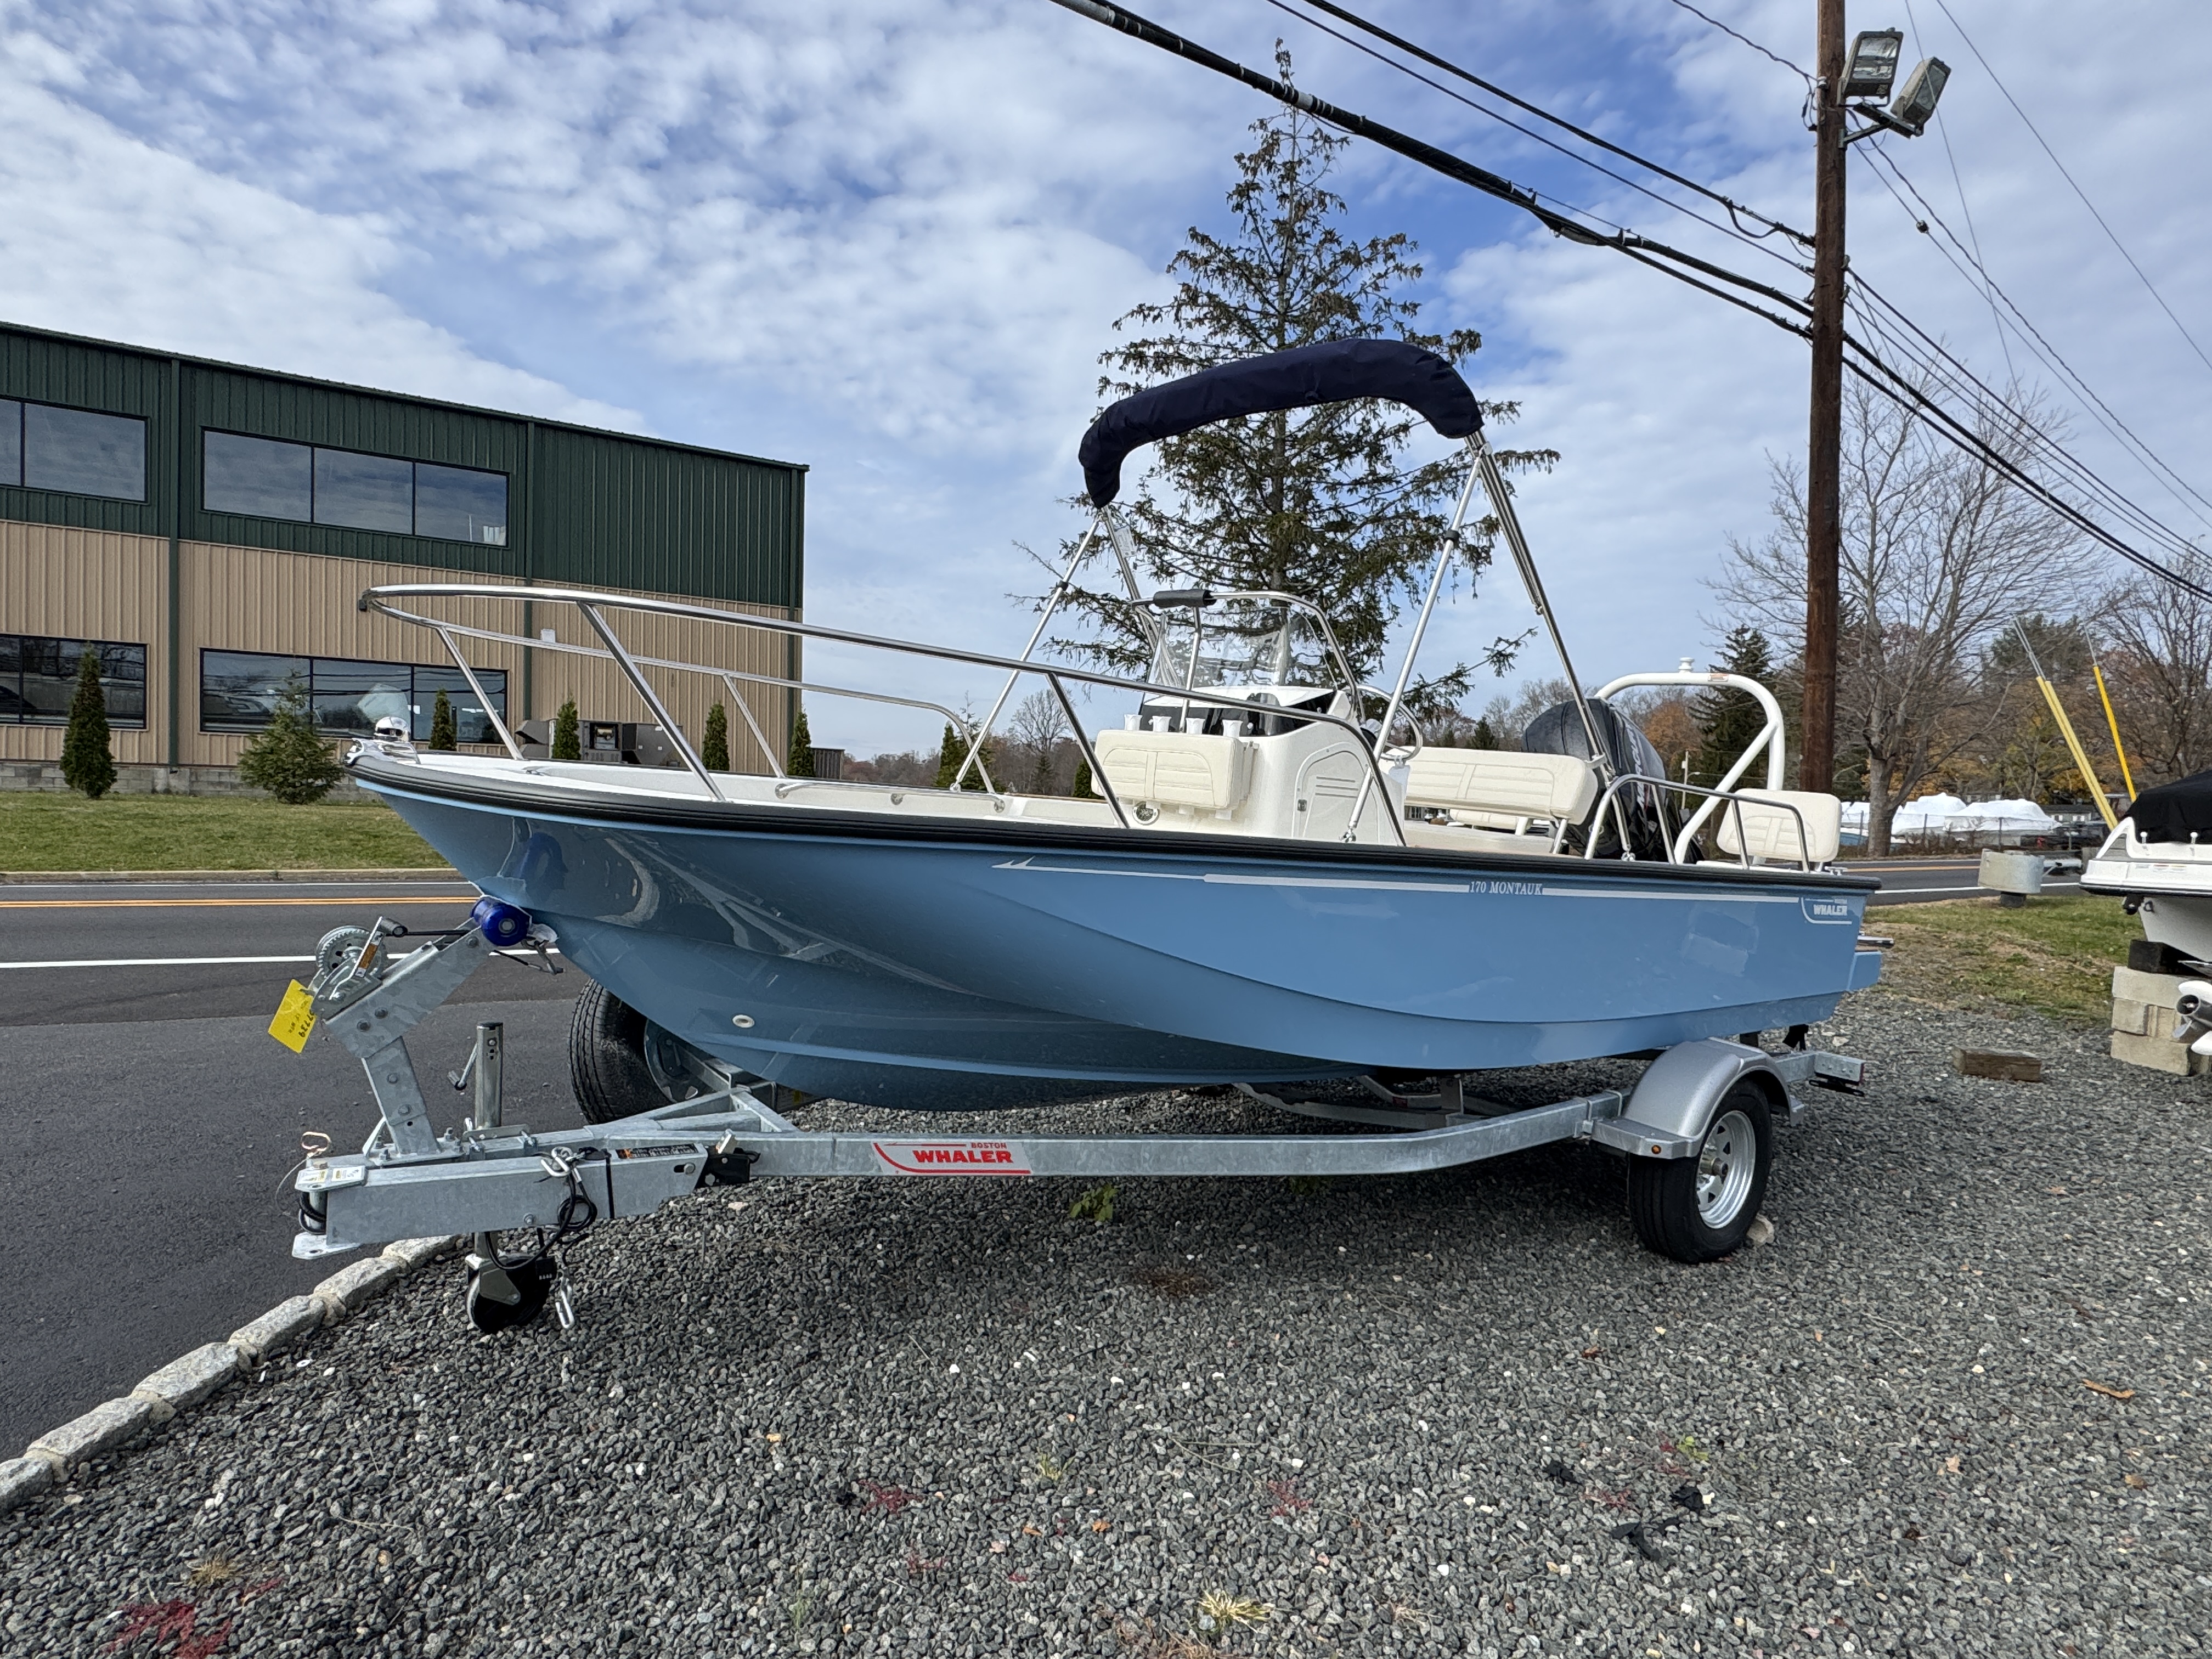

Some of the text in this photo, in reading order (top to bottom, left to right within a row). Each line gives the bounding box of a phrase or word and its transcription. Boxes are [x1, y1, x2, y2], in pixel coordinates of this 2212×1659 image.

[1470, 881, 1543, 895] 170 MONTAUK
[1813, 904, 1848, 916] WHALER
[912, 1150, 1014, 1163] WHALER
